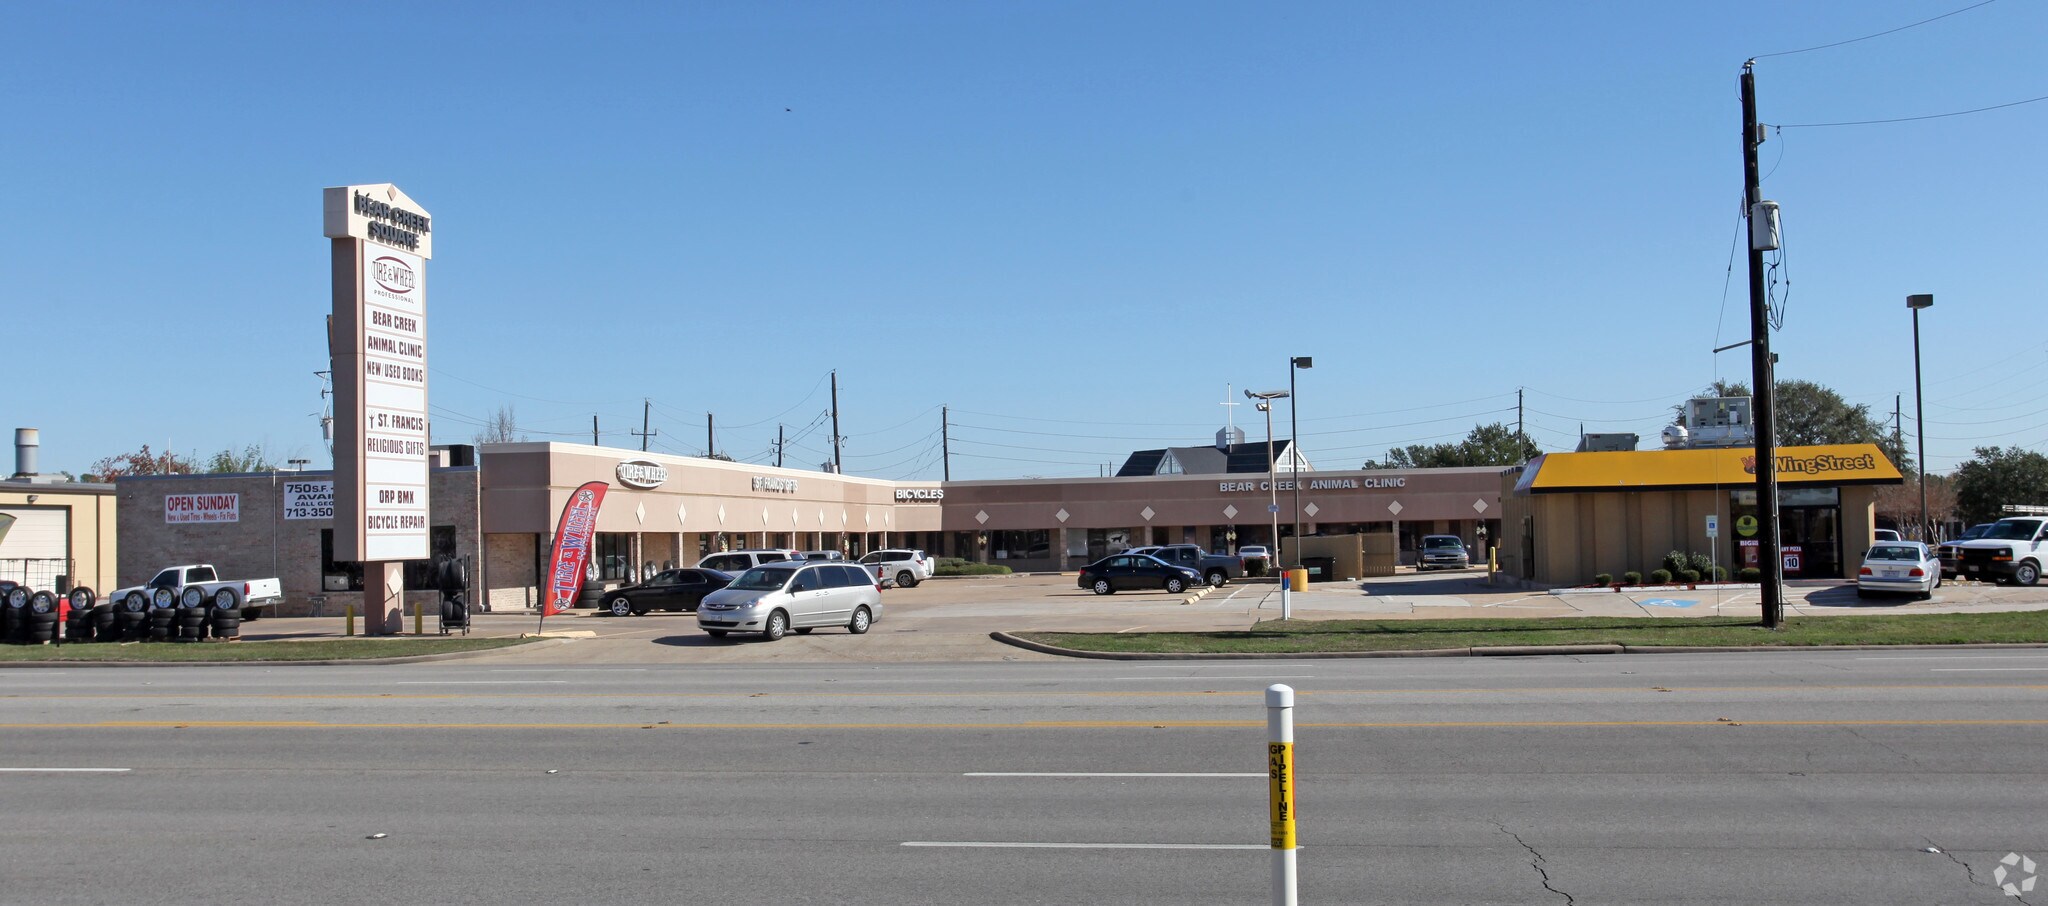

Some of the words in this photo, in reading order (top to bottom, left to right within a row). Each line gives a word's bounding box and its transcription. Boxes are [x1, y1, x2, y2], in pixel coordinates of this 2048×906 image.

[355, 195, 391, 220] BEAR
[391, 207, 430, 234] CREEK
[369, 220, 420, 250] SQUARE
[372, 261, 387, 282] TIRE
[393, 266, 416, 289] WHEEL
[374, 289, 414, 304] PROFESSIONAL
[372, 310, 392, 328] BEAR
[394, 315, 417, 333] CREEK
[368, 335, 397, 354] ANIMAL
[399, 341, 423, 358] CLINIC
[402, 367, 423, 382] BOOKS
[378, 413, 390, 428] ST.
[392, 415, 424, 431] FRANCIS
[367, 437, 404, 455] RELIGIOUS
[405, 440, 424, 456] GIFTS
[1775, 454, 1875, 474] WingStreet
[896, 489, 944, 499] BICYCLES
[1219, 482, 1254, 492] BEAR
[1310, 479, 1359, 490] ANIMAL
[1364, 477, 1406, 488] CLINIC
[168, 496, 194, 511] OPEN
[197, 495, 236, 511] SUNDAY
[379, 489, 395, 504] ORP
[397, 490, 414, 504] BMX
[368, 515, 398, 529] BICYCLE
[400, 515, 425, 529] REPAIR
[561, 504, 589, 549] WHEEL
[553, 560, 577, 592] TIRE
[1270, 745, 1278, 779] GAS
[1278, 745, 1287, 821] PIPELINE
